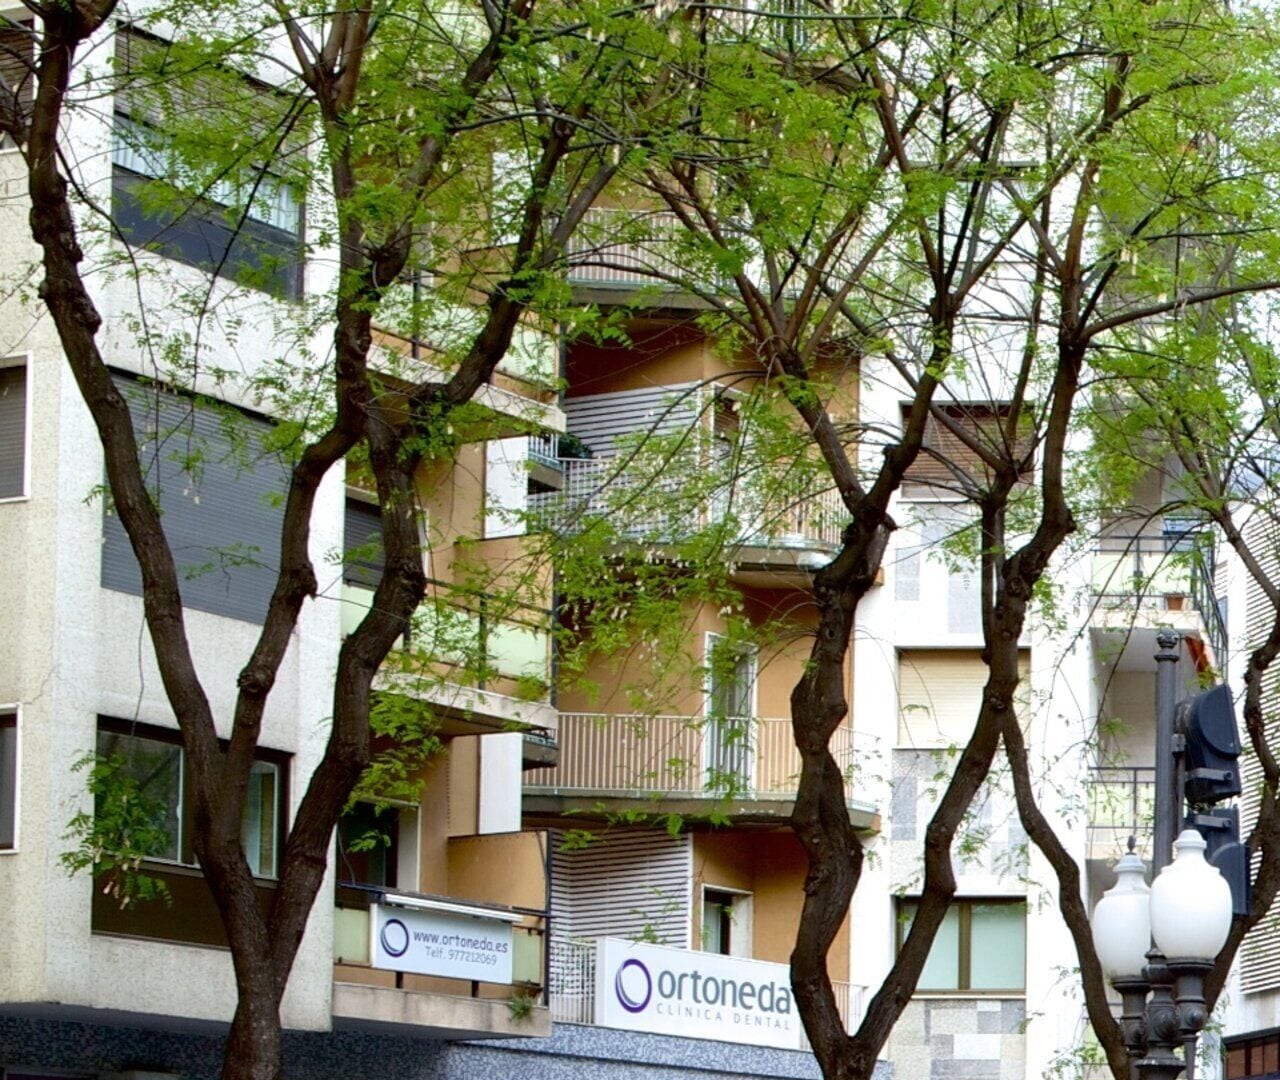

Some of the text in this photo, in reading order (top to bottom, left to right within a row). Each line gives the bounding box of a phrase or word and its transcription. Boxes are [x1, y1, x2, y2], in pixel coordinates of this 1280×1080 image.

[413, 930, 508, 953] www.ortoneda.es
[425, 946, 497, 966] Telf. 977212069
[657, 970, 791, 1014] ortoneda
[733, 1010, 791, 1031] DENTAL
